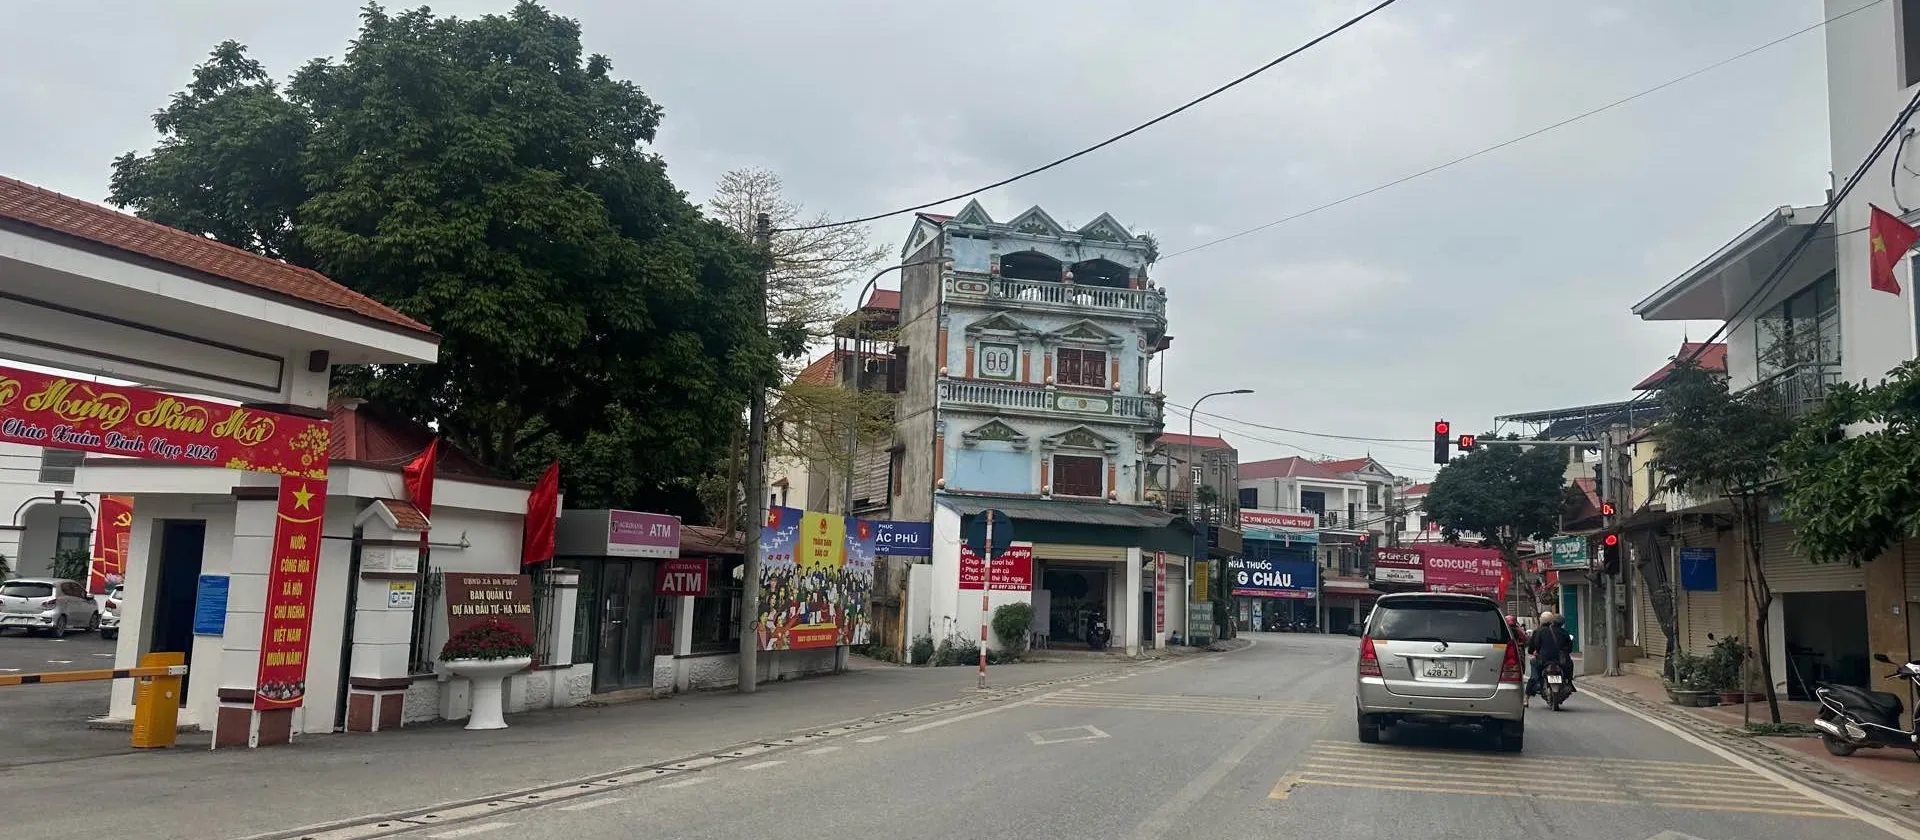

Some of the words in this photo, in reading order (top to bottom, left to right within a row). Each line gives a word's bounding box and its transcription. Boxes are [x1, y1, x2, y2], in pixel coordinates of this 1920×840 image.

[23, 379, 131, 430] Mừng
[135, 397, 209, 433] Năm
[211, 408, 276, 446] Mới
[2, 417, 48, 439] Chào
[52, 424, 101, 446] Xuân
[148, 436, 182, 459] Ngọ
[184, 443, 219, 460] 2026
[1240, 513, 1249, 524] ẮC
[649, 523, 671, 537] ATM
[875, 529, 892, 543] ẮC
[895, 531, 918, 543] PHÚ
[290, 533, 307, 550] NƯỚC
[280, 556, 297, 575] CỘNG
[1228, 558, 1245, 569] NHÀ
[1246, 559, 1272, 570] THUỐC
[662, 572, 702, 592] ATM
[1252, 570, 1292, 587] CHÂU
[470, 590, 485, 600] BAN
[486, 587, 504, 600] QUẢN
[505, 588, 513, 600] LÝ
[274, 601, 287, 619] CHỦ
[452, 604, 462, 618] DỰ
[475, 600, 489, 615] ĐẦU
[513, 600, 531, 614] TẦNG
[273, 625, 287, 645] VIỆT
[287, 628, 302, 643] NAM
